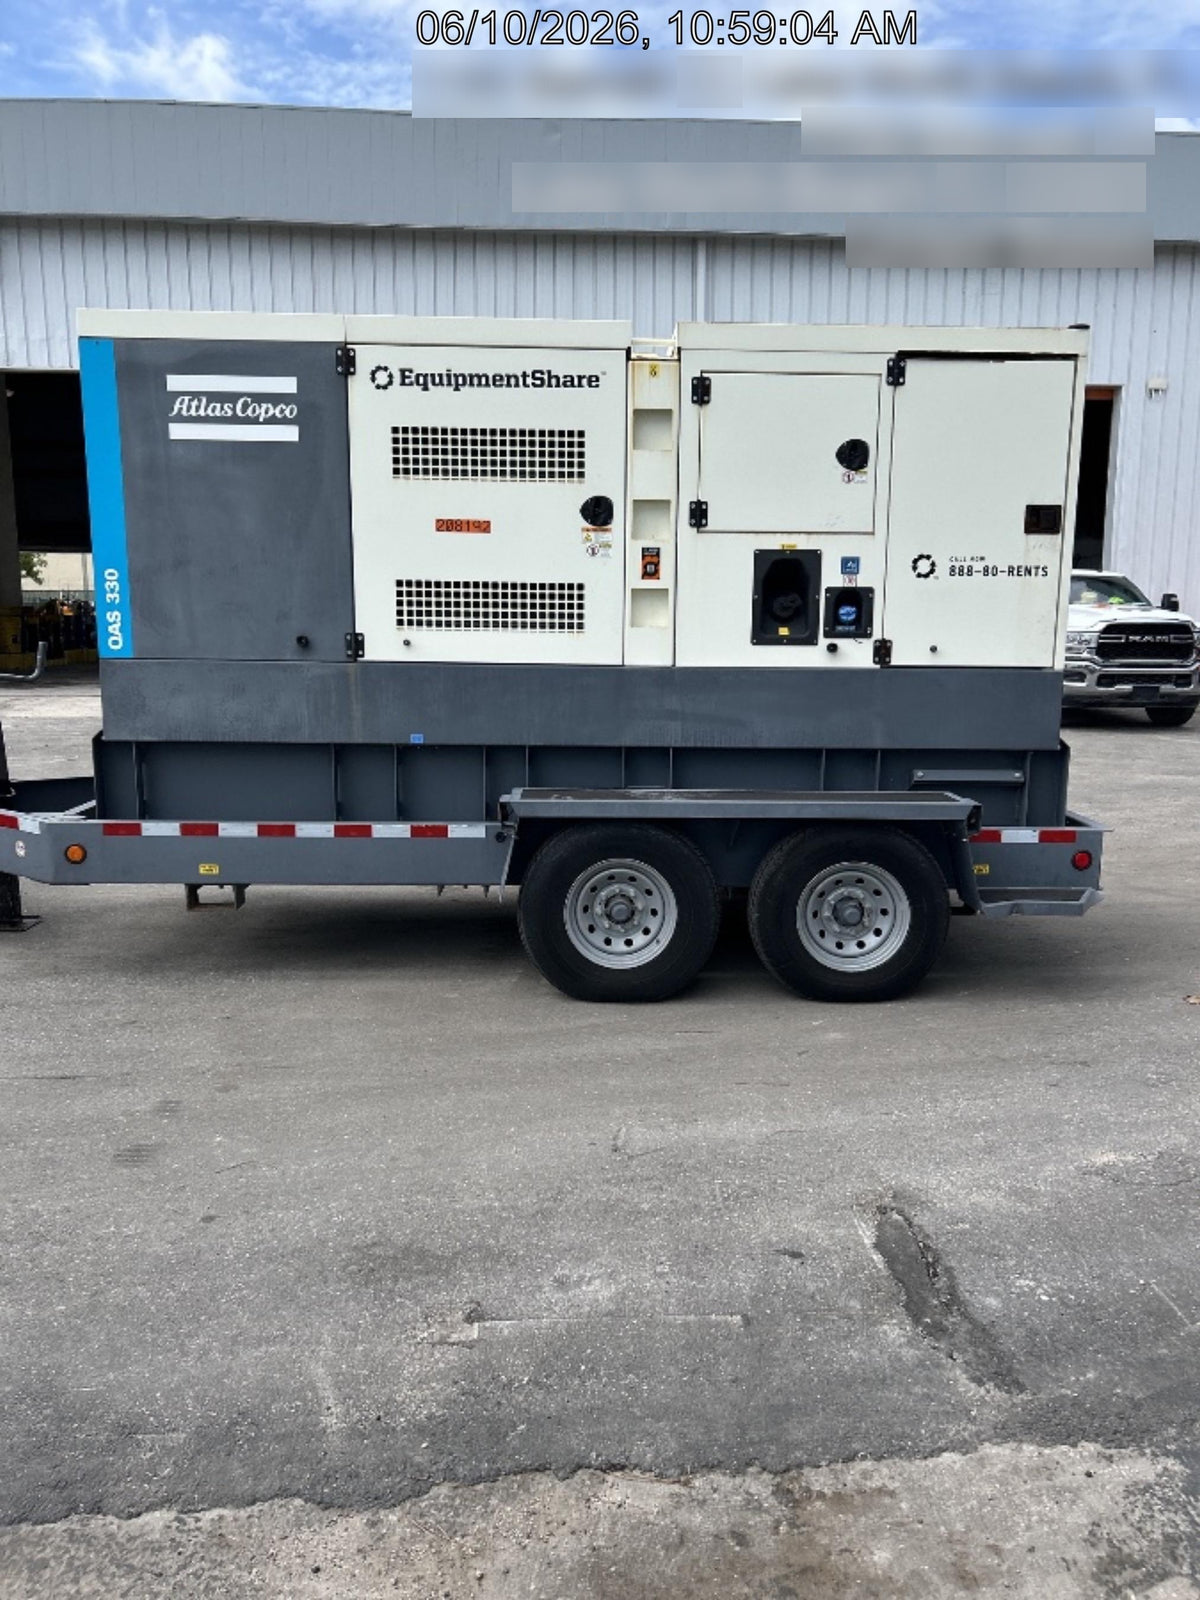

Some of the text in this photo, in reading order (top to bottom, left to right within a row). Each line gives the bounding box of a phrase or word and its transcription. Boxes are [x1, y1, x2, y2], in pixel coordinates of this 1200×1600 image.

[398, 367, 601, 391] EquipmentShare
[168, 395, 298, 422] Atlas Copco
[948, 564, 1048, 577] 888-80-RENTS
[103, 568, 120, 605] 330
[1128, 635, 1169, 643] RAM
